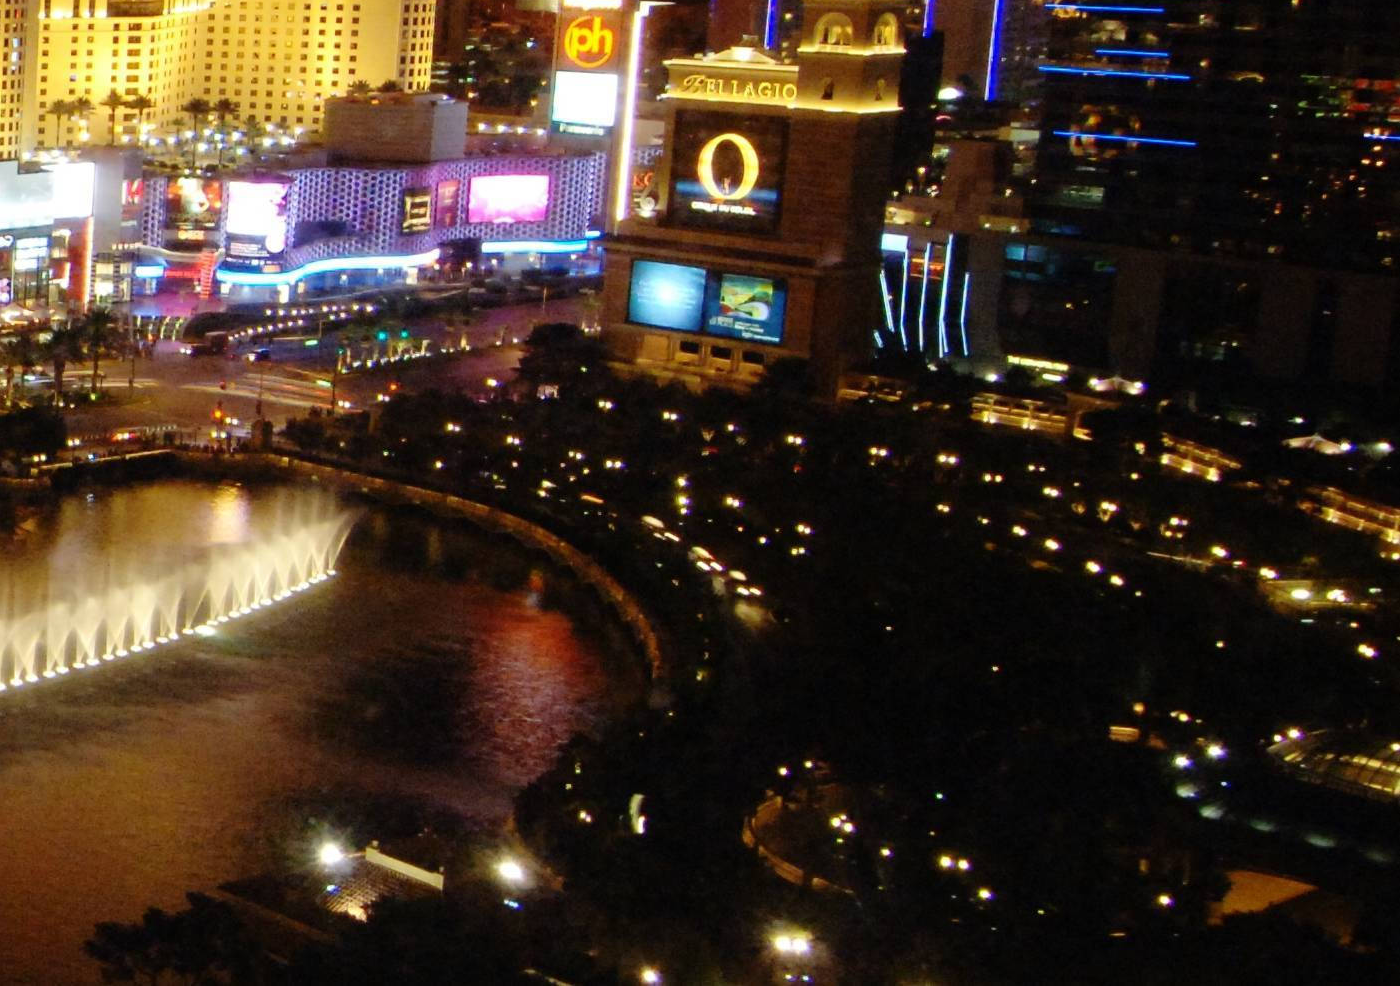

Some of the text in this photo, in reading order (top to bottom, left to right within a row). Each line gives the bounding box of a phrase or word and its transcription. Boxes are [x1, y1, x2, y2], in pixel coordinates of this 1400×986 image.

[565, 15, 614, 69] ph
[683, 74, 798, 100] BELLAGIO
[697, 133, 760, 200] O
